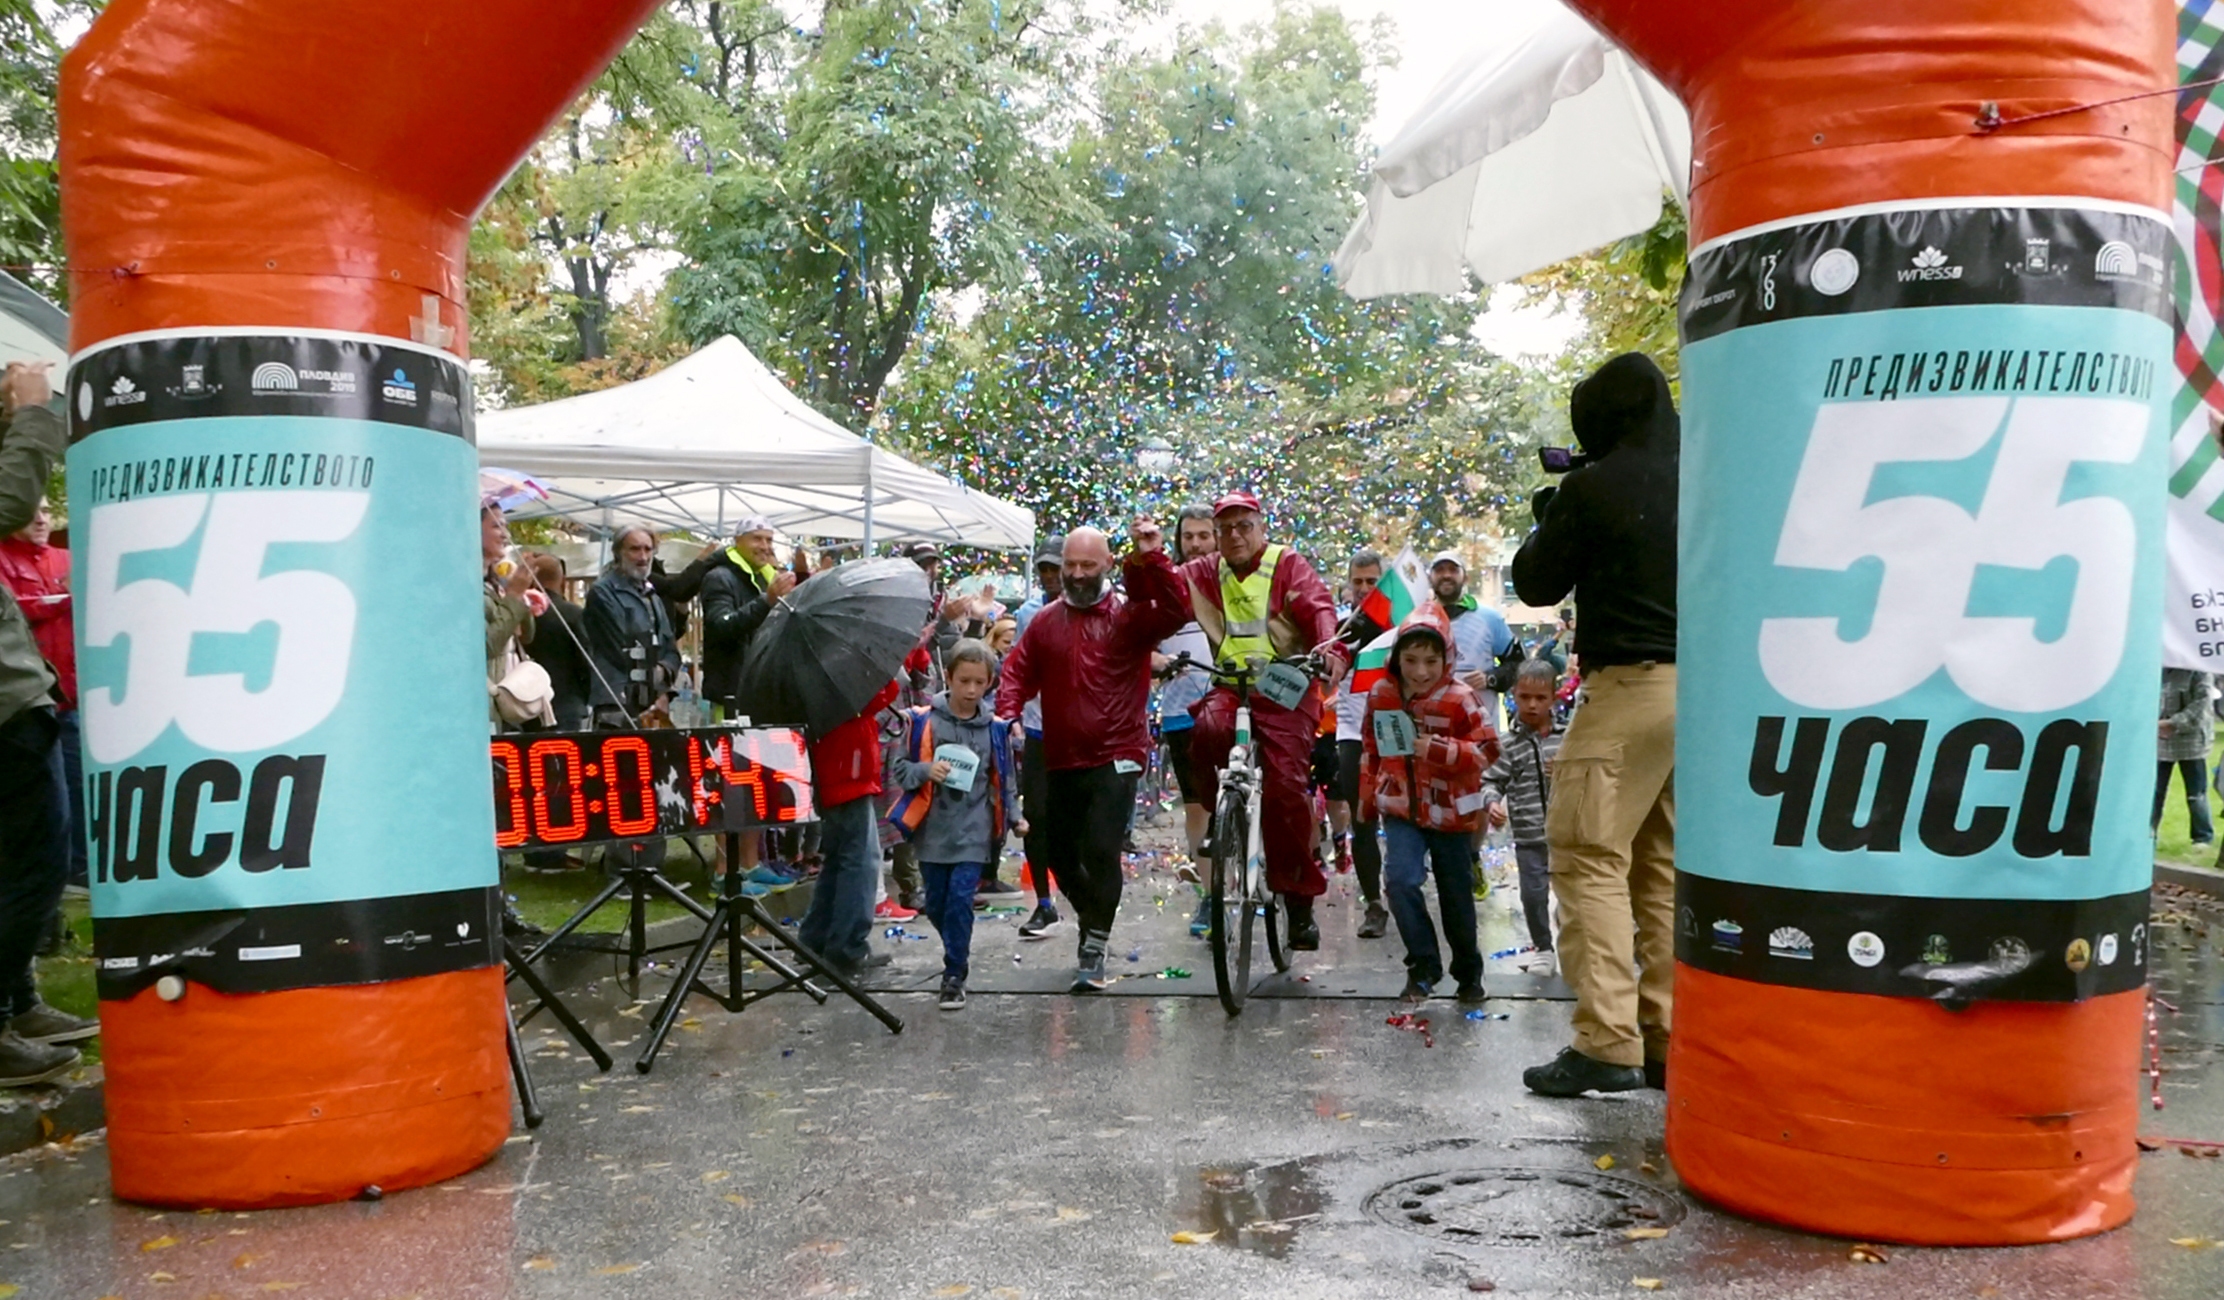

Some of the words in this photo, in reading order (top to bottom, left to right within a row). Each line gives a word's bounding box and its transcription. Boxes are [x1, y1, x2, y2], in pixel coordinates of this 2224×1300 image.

[300, 370, 355, 382] ПЛОВДИВ
[330, 382, 356, 393] 2019
[91, 453, 375, 503] ПРЕДИЗВИКАТЕЛСТВОТО
[1757, 396, 2151, 713] 55
[85, 490, 371, 765] 55
